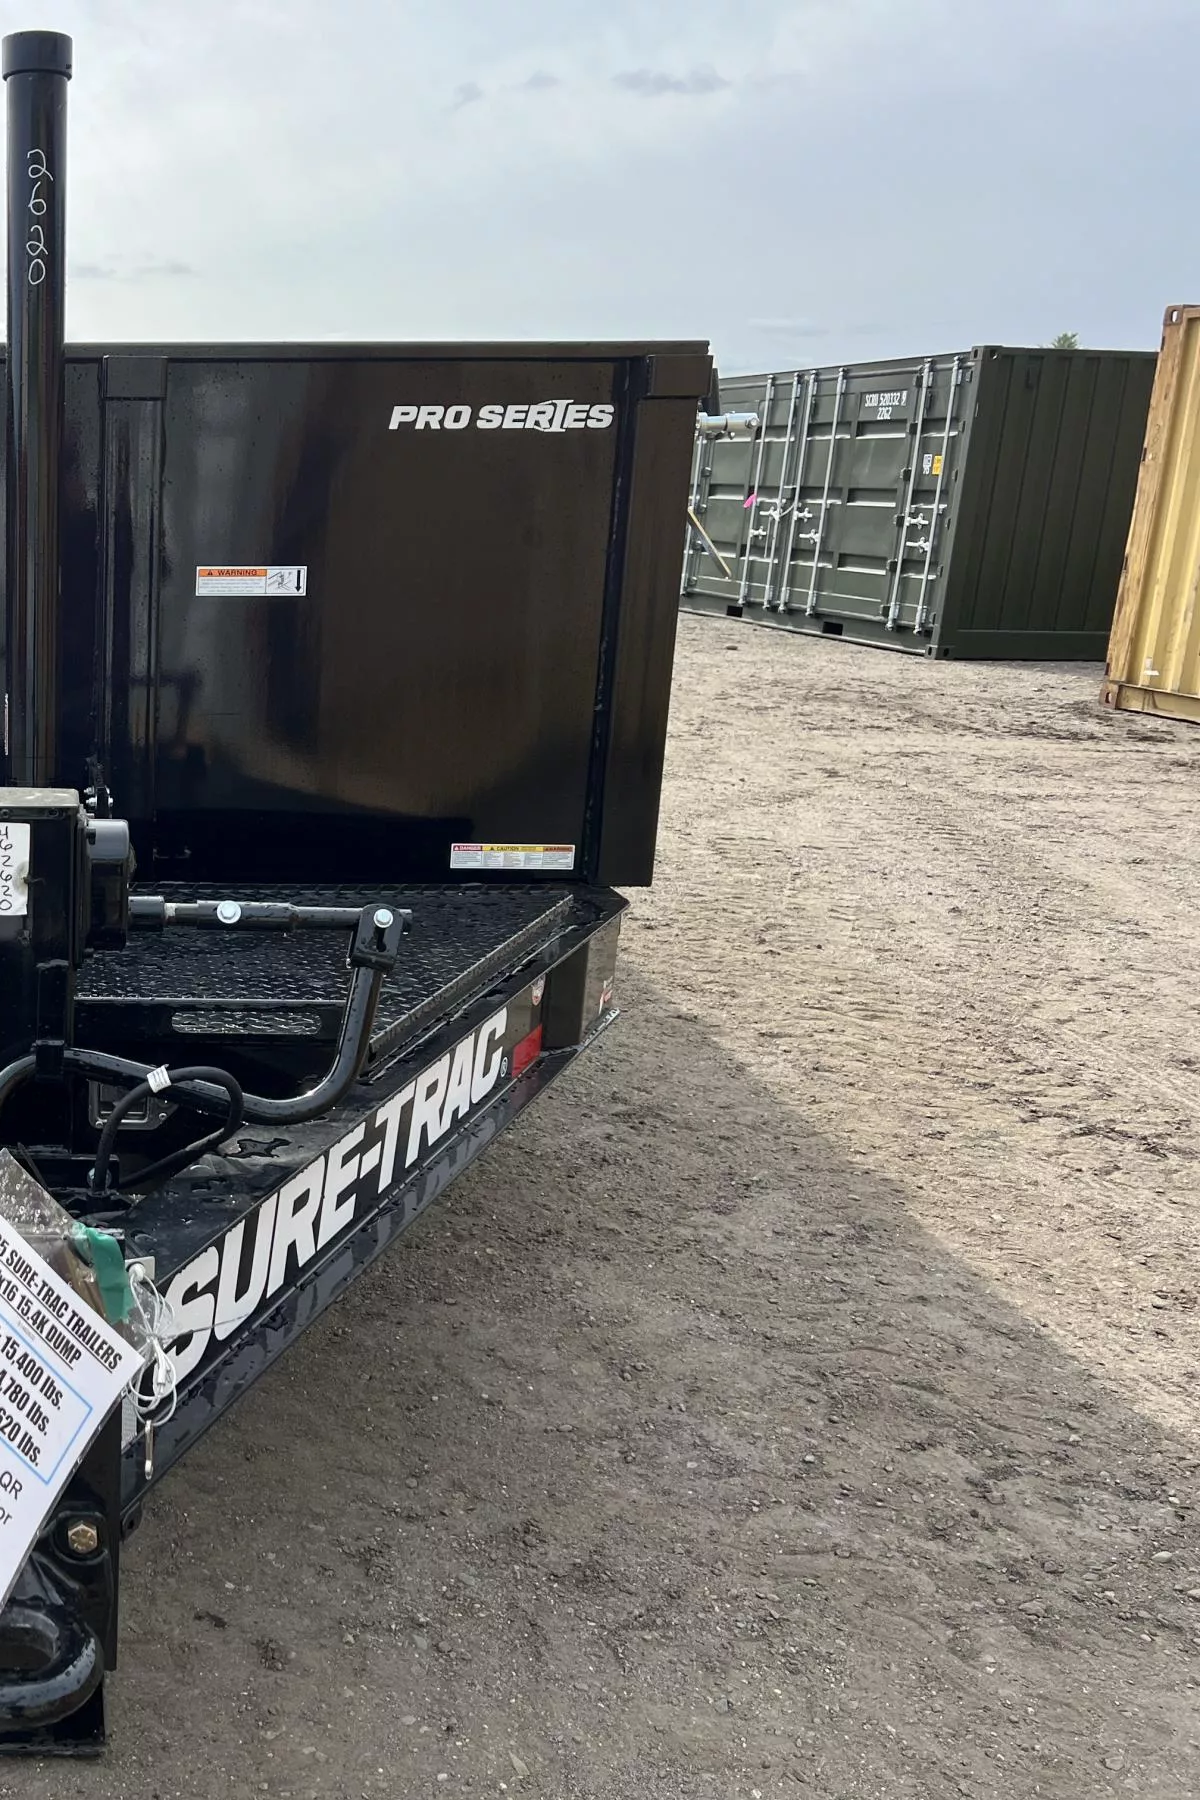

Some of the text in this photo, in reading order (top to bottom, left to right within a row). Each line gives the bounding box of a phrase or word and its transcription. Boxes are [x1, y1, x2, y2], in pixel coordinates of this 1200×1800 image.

[26, 148, 53, 285] 2620
[388, 399, 615, 432] PRO SERIES
[879, 392, 901, 406] 520332
[217, 569, 258, 577] WARNING
[6, 1249, 69, 1319] SURE-TRAC
[66, 1310, 122, 1370] TRAILERS
[16, 1291, 50, 1335] 15.4K
[45, 1325, 82, 1366] DUMP
[0, 1336, 44, 1385] 15,400
[39, 1376, 63, 1411] lbs.
[26, 1401, 50, 1436] lbs.
[17, 1432, 40, 1467] lbs.
[0, 1471, 23, 1500] QR
